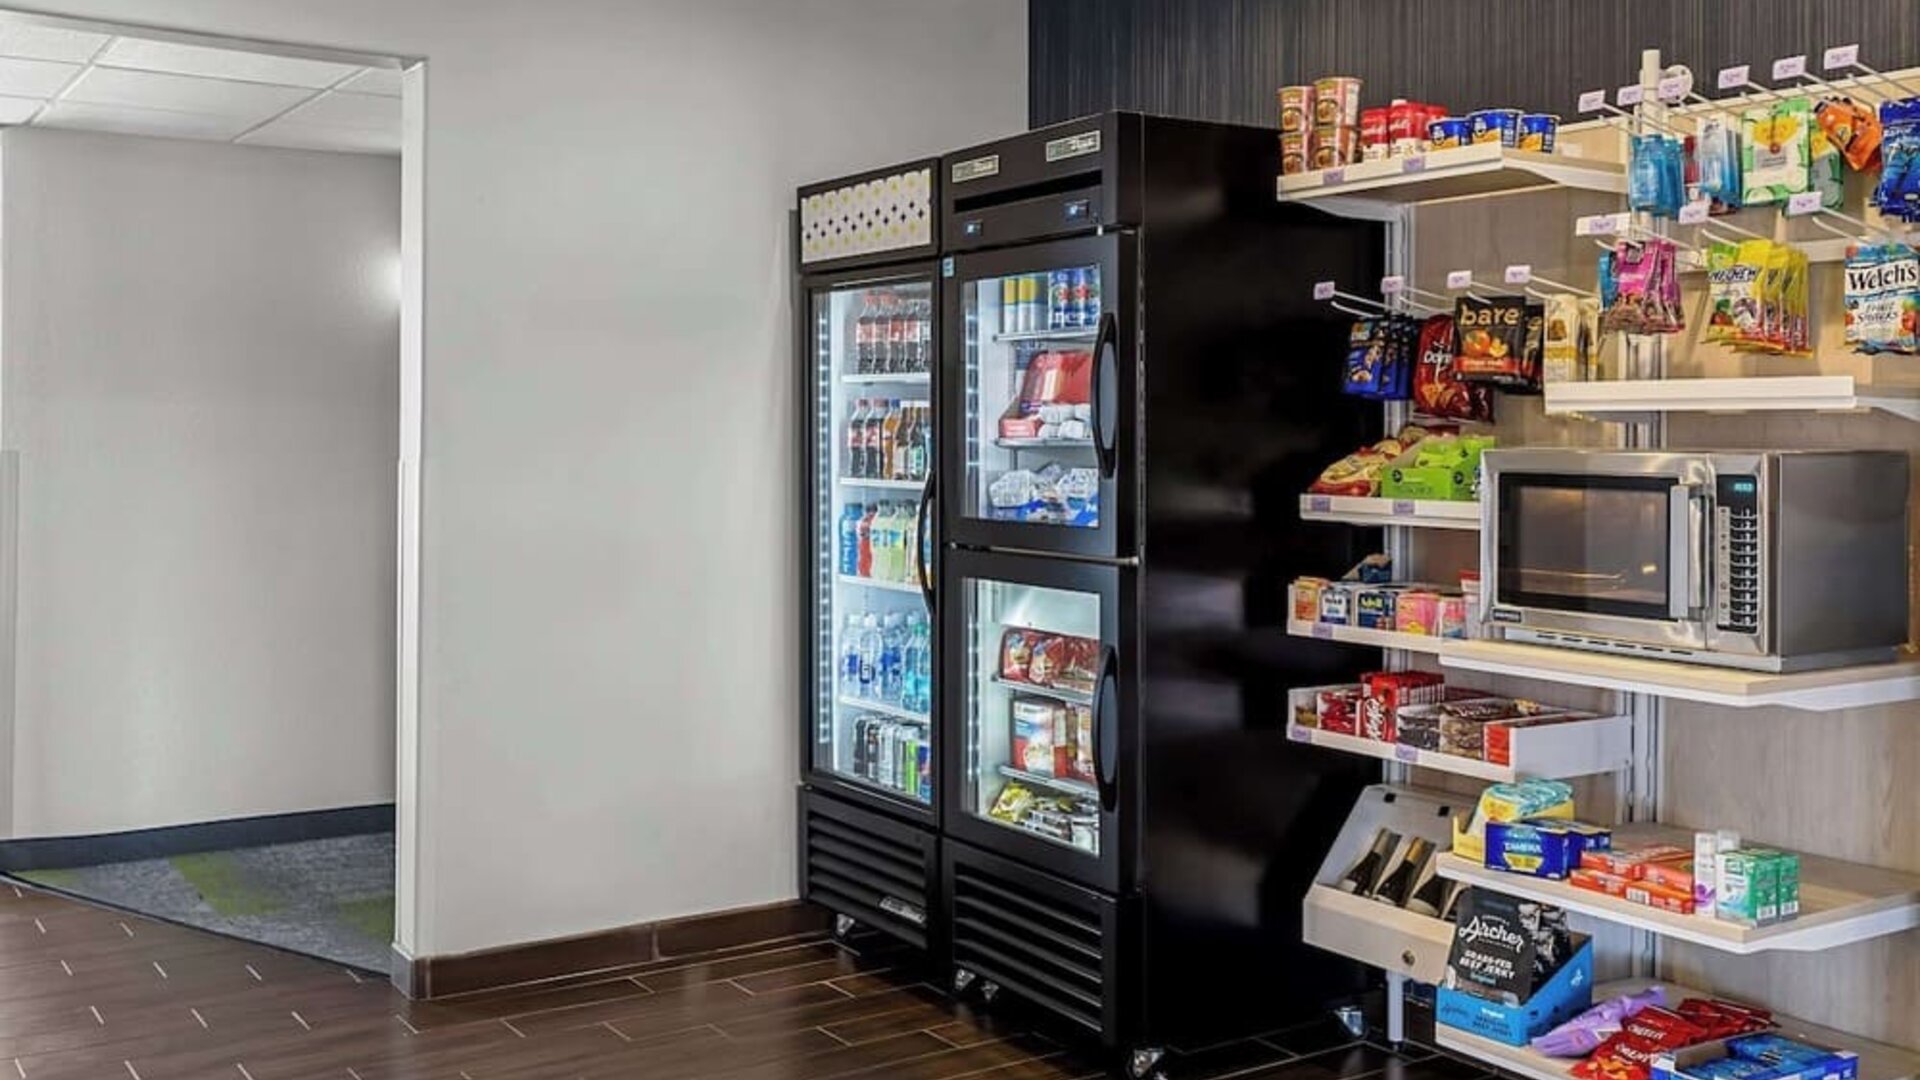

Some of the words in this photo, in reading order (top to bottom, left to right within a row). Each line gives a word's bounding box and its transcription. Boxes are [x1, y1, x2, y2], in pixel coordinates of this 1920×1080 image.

[1849, 263, 1917, 291] Welch's
[1460, 304, 1520, 326] bare
[1458, 914, 1524, 954] Archer
[1459, 957, 1483, 972] BEEF
[1483, 963, 1516, 980] JERKY
[1464, 949, 1513, 970] GRASS-FED
